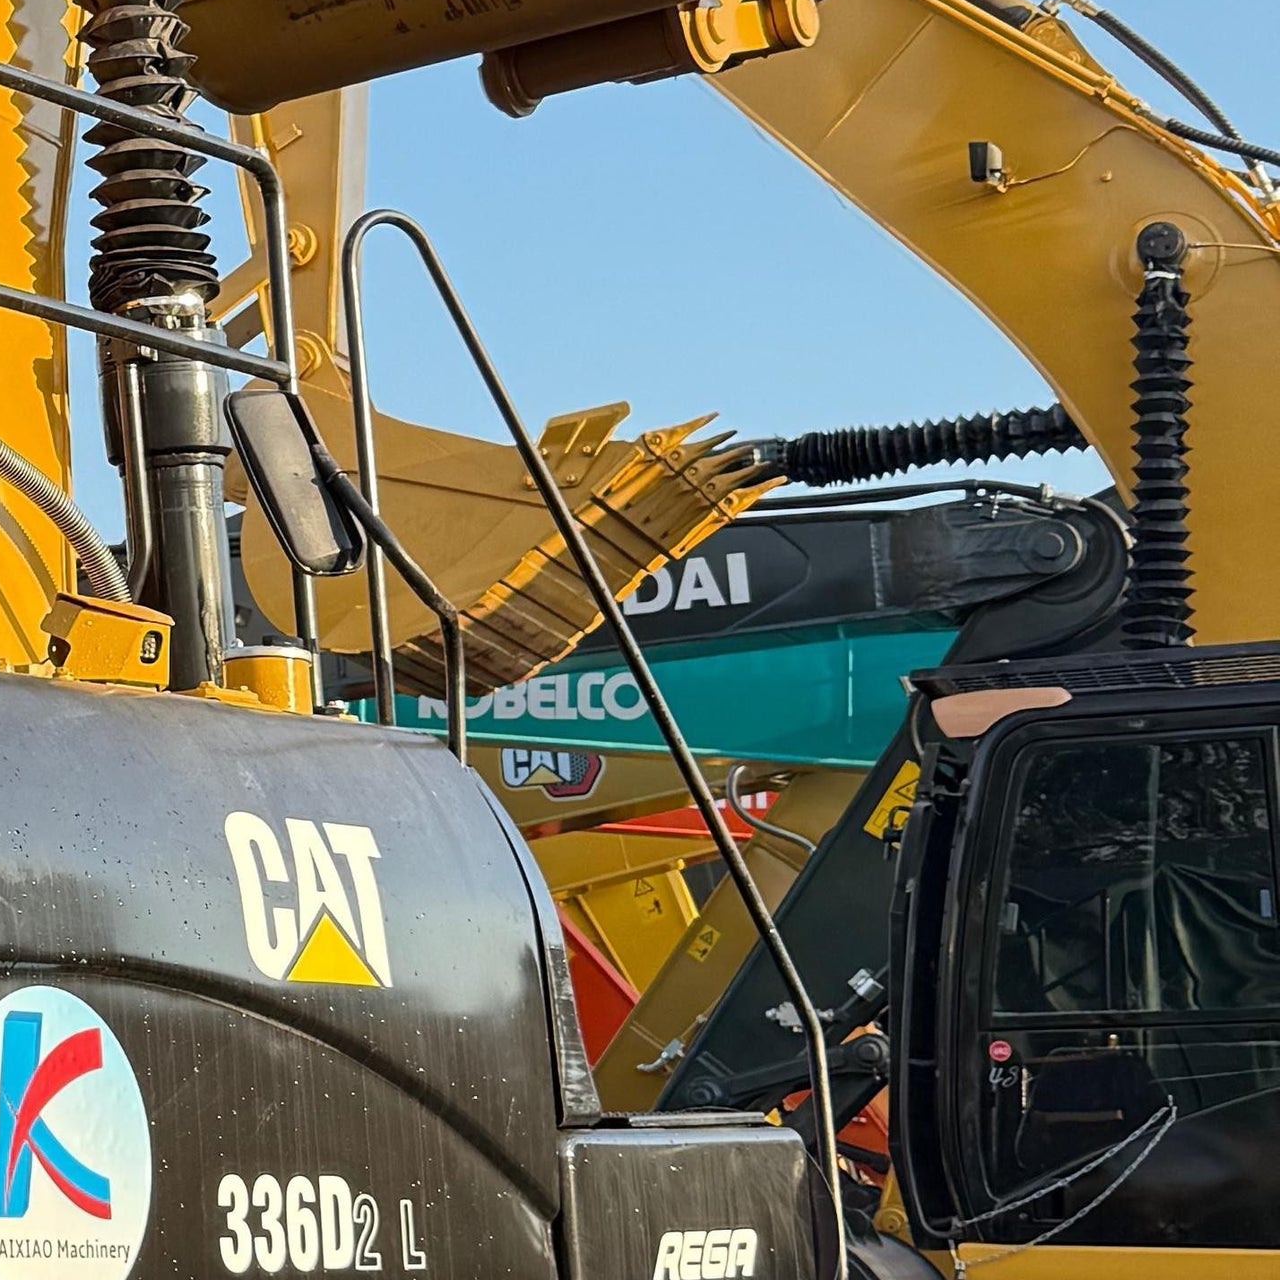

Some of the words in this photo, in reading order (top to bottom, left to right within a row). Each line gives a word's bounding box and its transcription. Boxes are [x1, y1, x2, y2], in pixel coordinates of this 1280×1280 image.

[224, 811, 393, 988] CAT
[57, 1238, 130, 1264] Machinery
[399, 1198, 427, 1271] L
